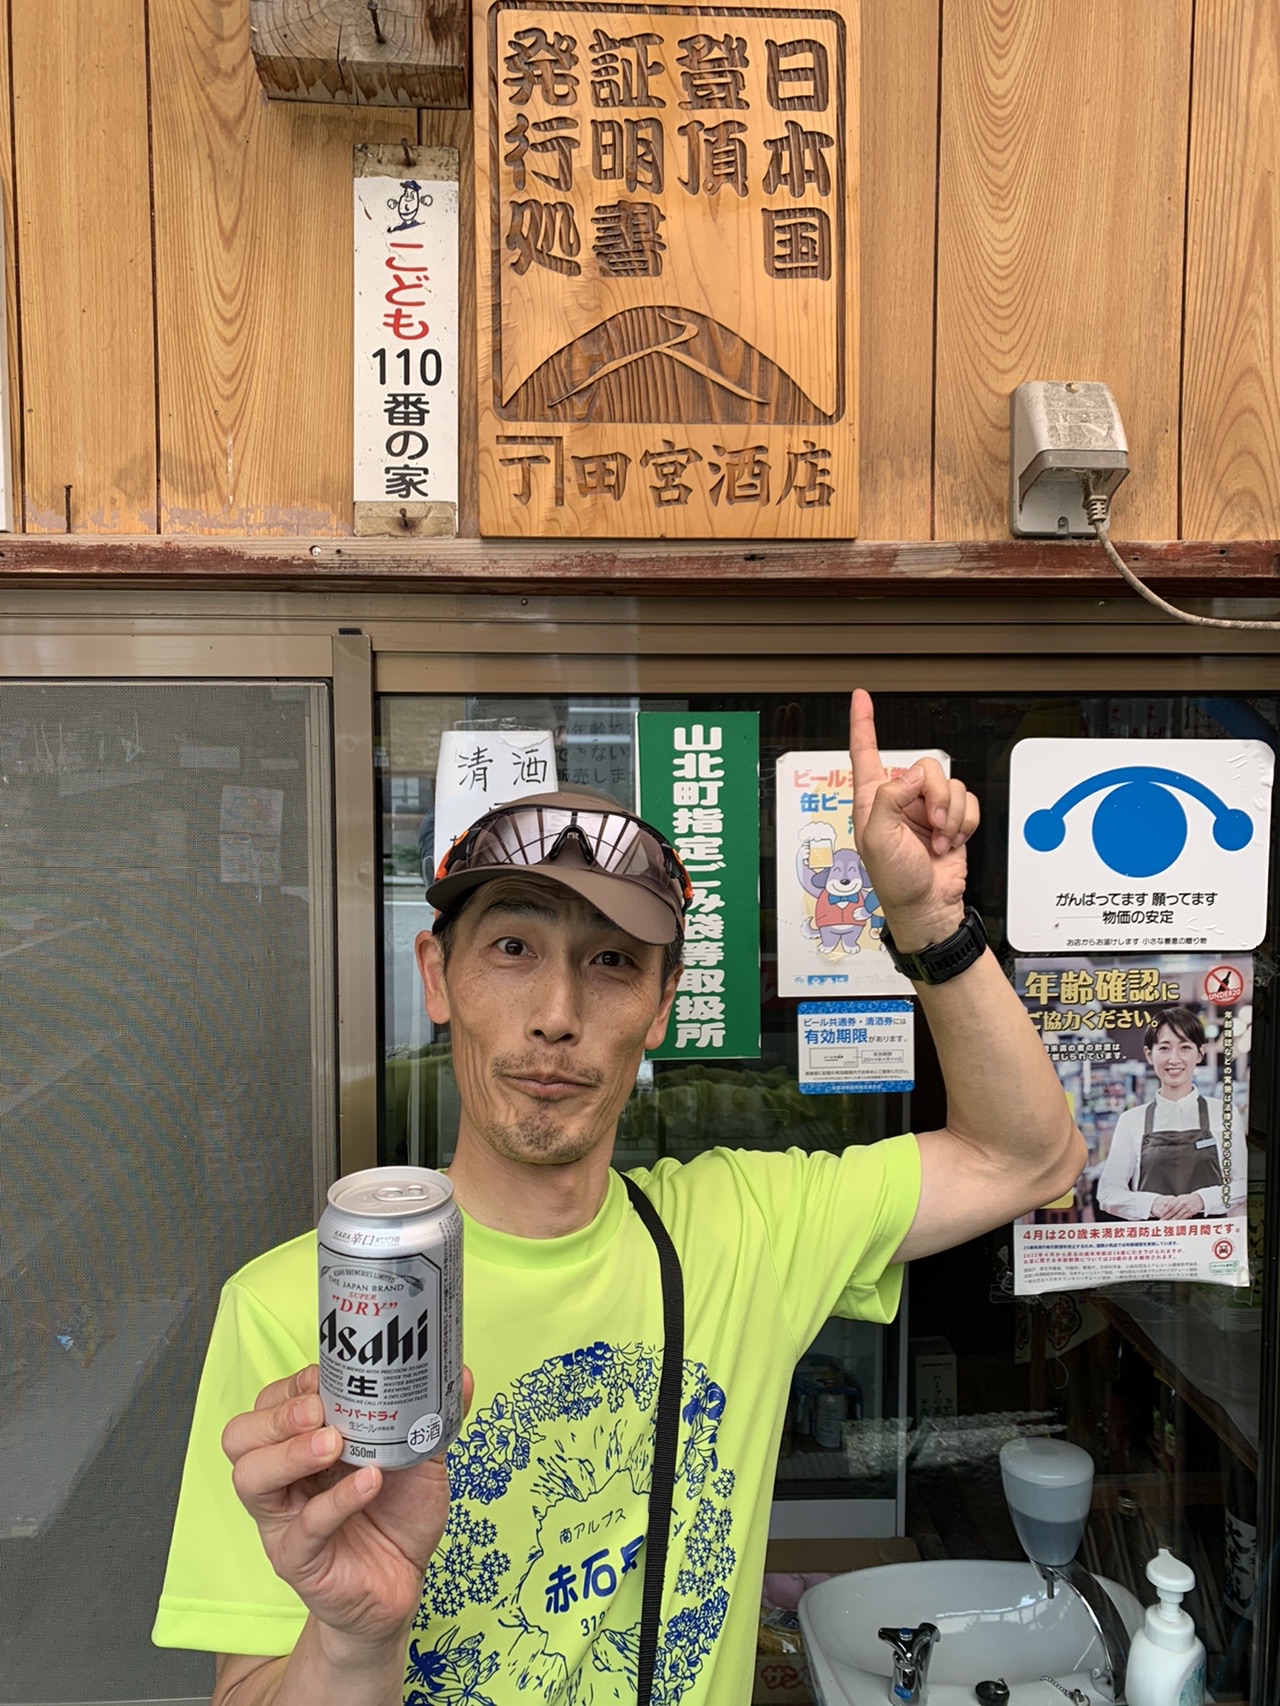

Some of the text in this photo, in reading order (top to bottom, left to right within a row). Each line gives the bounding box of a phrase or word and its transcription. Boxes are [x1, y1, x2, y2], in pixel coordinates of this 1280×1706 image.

[676, 32, 751, 197] 登頂
[502, 28, 582, 277] 発行処
[589, 28, 667, 278] 証明書
[762, 37, 836, 281] 日本国
[372, 242, 442, 499] こども110番の家
[556, 744, 631, 762] できない
[557, 767, 631, 785] 販売しま
[800, 792, 853, 812] 缶ビー
[1056, 892, 1218, 907] がんばってます 願ってます
[1102, 909, 1175, 925] 物価の安定
[1066, 938, 1140, 946] お店からお届けします
[1025, 968, 1180, 1006] 年齢確認に
[1027, 1009, 1159, 1032] ご協力ください。
[351, 1232, 375, 1246] 辛口
[1023, 1223, 1241, 1241] 4月は20歳未満飲酒防止強調月間です。
[328, 1275, 404, 1292] THE JAPAN BRAND
[348, 1291, 377, 1300] SUPER
[319, 1308, 428, 1366] Asahi
[346, 1375, 379, 1398] 生
[334, 1403, 398, 1421] スーパードライ
[409, 1421, 440, 1446] お酒
[350, 1445, 376, 1459] 350ml
[560, 1508, 627, 1545] 南アルプス
